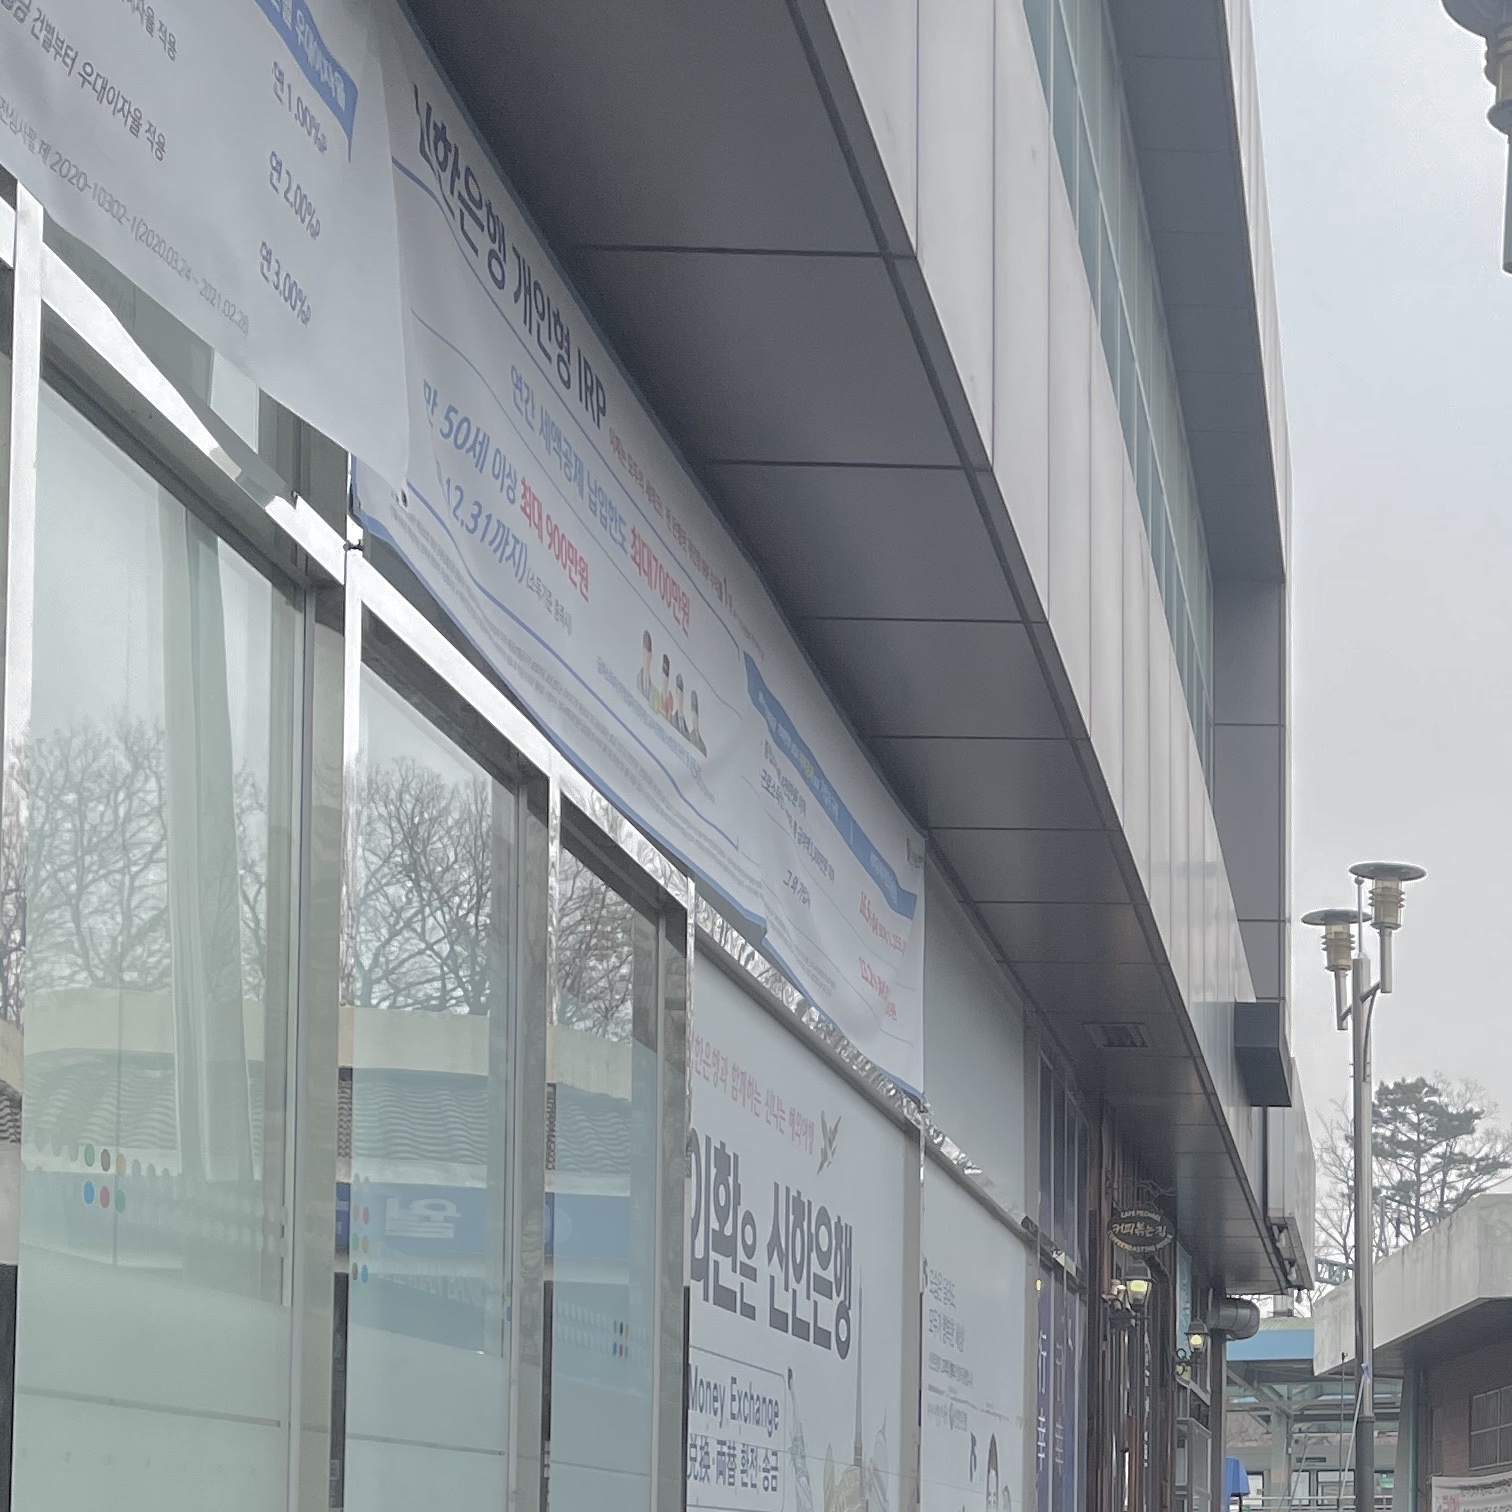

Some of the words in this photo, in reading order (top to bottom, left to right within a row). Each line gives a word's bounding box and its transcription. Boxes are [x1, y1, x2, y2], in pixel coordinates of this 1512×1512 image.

[30, 7, 79, 77] 건별부터
[77, 61, 143, 139] 우대이자율
[145, 120, 166, 162] 적용
[158, 20, 178, 62] 적용
[512, 243, 571, 390] 개인형
[577, 346, 607, 431] IRP
[439, 403, 491, 475] 50세
[491, 446, 518, 506] 이상
[519, 476, 544, 545] 최대
[545, 512, 589, 603] 900만원
[511, 364, 536, 432] 연간
[539, 404, 585, 501] 세액공제
[766, 1180, 854, 1361] 신한은행
[688, 1362, 726, 1430] Money
[730, 1375, 780, 1439] Exchange
